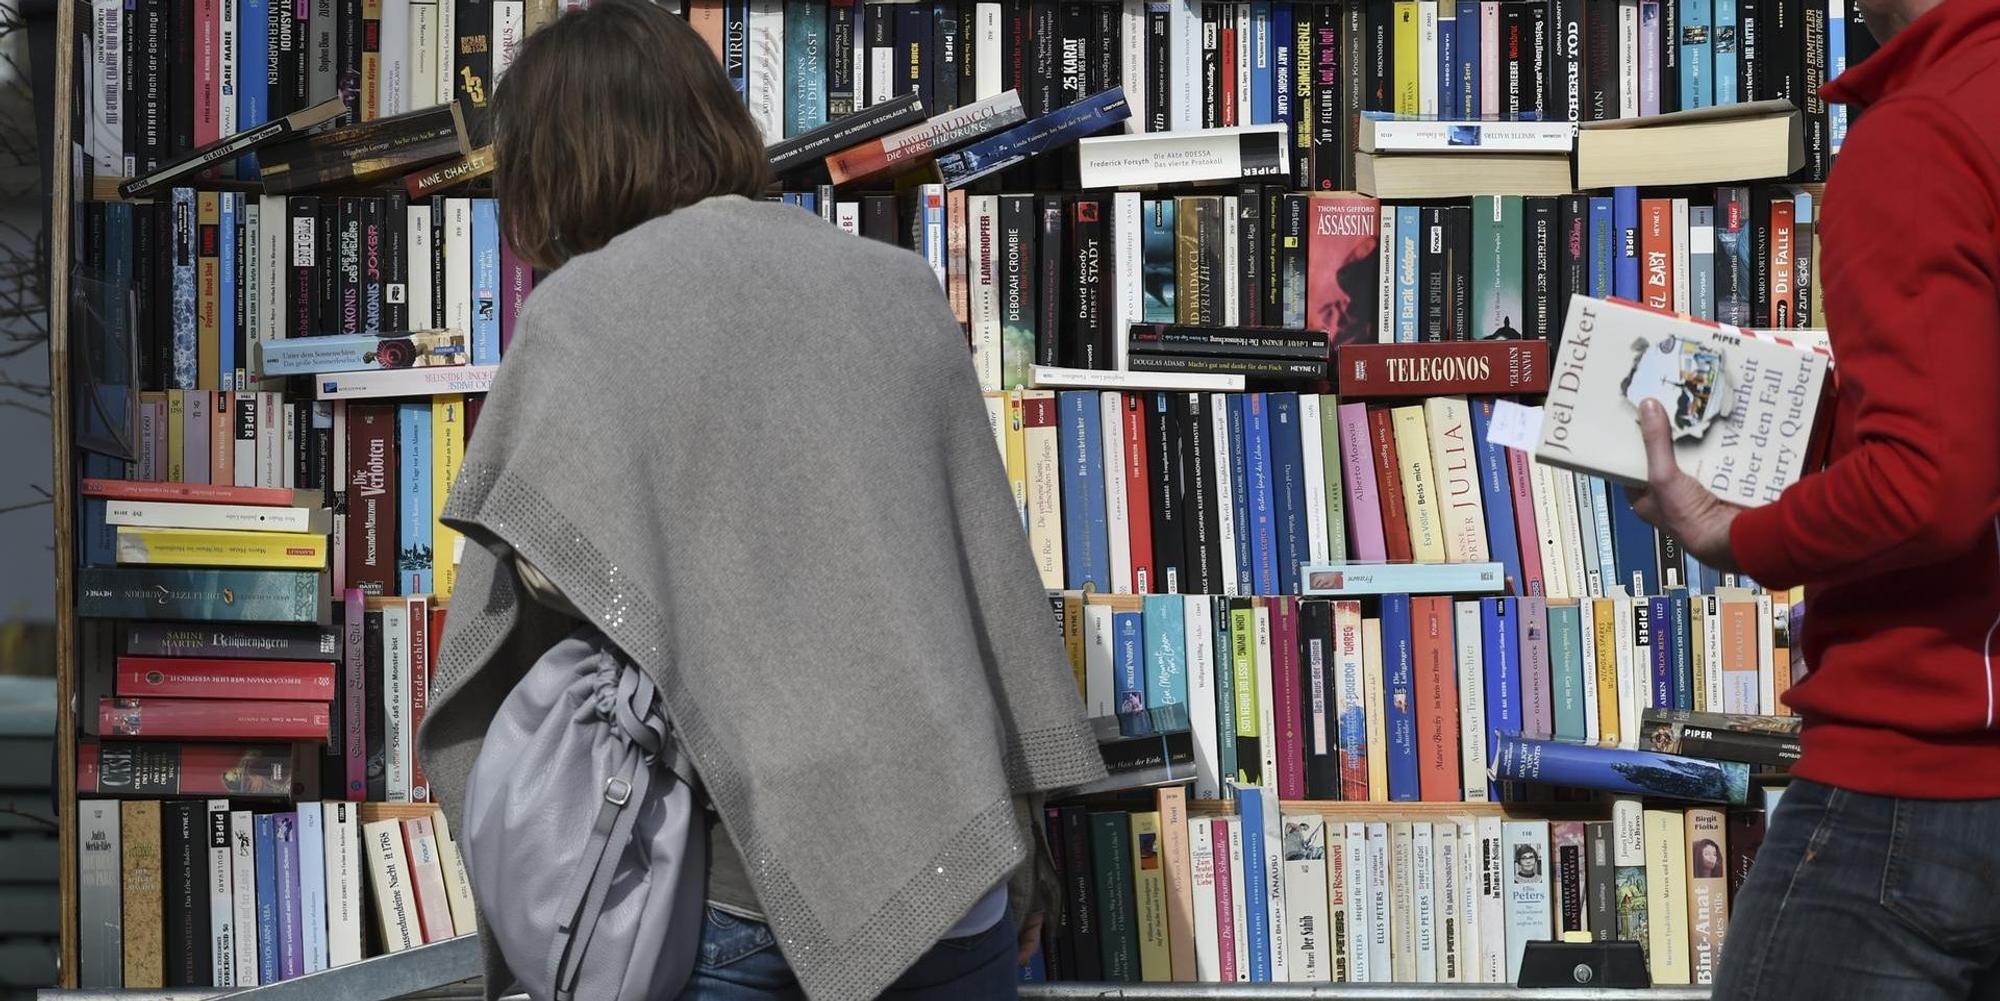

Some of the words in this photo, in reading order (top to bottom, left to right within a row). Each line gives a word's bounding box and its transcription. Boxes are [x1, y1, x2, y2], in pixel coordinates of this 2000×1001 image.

[148, 12, 160, 54] Schlange
[280, 11, 292, 51] ASMODI
[1745, 18, 1754, 45] RATTEN
[1816, 10, 1824, 32] FORCE
[223, 31, 232, 62] MARIE
[730, 21, 743, 70] VIRUS
[808, 32, 816, 74] ANGST
[911, 42, 919, 64] BUICK
[946, 36, 954, 62] PIPER
[1534, 21, 1544, 71] Valentinstag
[1566, 22, 1578, 58] TOD
[1745, 46, 1754, 60] DIE
[1806, 9, 1816, 95] EURO-ERMITTLER
[1816, 34, 1824, 68] COUNTER
[148, 55, 158, 71] der
[1062, 38, 1078, 74] KARAT
[1278, 46, 1288, 66] MARY
[1298, 22, 1310, 96] SCHMERZGRENZE
[148, 74, 158, 98] Nacht
[223, 65, 232, 96] MARIE
[798, 57, 806, 98] STEVENS
[911, 66, 919, 79] DER
[1062, 76, 1078, 90] 25
[1278, 67, 1288, 94] HIGGINS
[1746, 62, 1754, 90] Herbert
[808, 80, 816, 100] DIE
[1278, 95, 1288, 115] CLARK
[1535, 71, 1544, 112] Schwarzer
[1567, 62, 1578, 137] SICHERE
[808, 106, 816, 120] IN
[1807, 97, 1816, 114] DIE
[148, 102, 158, 145] WATKINS
[834, 132, 844, 140] MIT
[844, 120, 871, 137] BLINDHEIT
[872, 106, 908, 126] GESCHLAGEN
[898, 131, 930, 148] DAVID
[930, 104, 998, 138] BALDACCI
[1812, 121, 1820, 150] Molsner
[886, 146, 902, 162] DIE
[902, 122, 986, 156] VERSCHWÖRUNG
[418, 172, 442, 190] ANNE
[444, 158, 486, 180] CHAPLET
[1247, 224, 1256, 239] Riga
[1317, 214, 1374, 237] ASSASSINI
[1730, 208, 1738, 228] Knaur
[298, 218, 311, 266] ENIGMA
[342, 231, 350, 255] SPUR
[350, 221, 358, 262] SPIELERS
[368, 224, 379, 280] JOKER
[980, 216, 991, 286] FLAMMENOPFER
[1008, 228, 1019, 272] CROMBIE
[1432, 232, 1440, 252] Knaur
[1538, 219, 1546, 271] LEHRLING
[1626, 229, 1634, 256] PIPER
[1758, 227, 1766, 276] FORTUNATO
[342, 257, 350, 272] DIE
[350, 264, 358, 282] DES
[1080, 248, 1088, 284] Moody
[1088, 238, 1098, 284] STADT
[1247, 256, 1256, 278] Hunde
[1189, 250, 1200, 308] BALDACCI
[1538, 273, 1546, 292] DER
[1758, 276, 1766, 304] MARIO
[344, 288, 356, 334] KAKONIS
[366, 282, 380, 333] KAKONIS
[1008, 275, 1020, 320] DEBORAH
[1080, 288, 1088, 318] David
[1558, 306, 1596, 394] Dicker
[1386, 356, 1490, 383] TELEGONOS
[1522, 351, 1532, 383] HANNS
[1760, 368, 1783, 406] Fall
[1781, 356, 1815, 438] Quebert
[1721, 358, 1760, 450] Wahrheit
[1544, 402, 1575, 452] Joël
[1750, 409, 1774, 446] den
[1348, 422, 1360, 464] Moravia
[352, 470, 366, 485] Die
[360, 439, 386, 496] Verlobten
[1444, 424, 1478, 509] JULIA
[1490, 456, 1498, 470] SWIFT
[1712, 455, 1736, 492] Die
[1736, 448, 1758, 499] über
[1353, 466, 1364, 502] Alberto
[1492, 471, 1500, 492] GRAHAM
[365, 498, 376, 528] Manzoni
[365, 528, 376, 566] Alessandro
[90, 590, 112, 598] HEYNE
[166, 630, 204, 640] SABINE
[1638, 608, 1648, 644] PIPER
[162, 640, 204, 648] MARTIN
[414, 630, 422, 670] stehlen
[1310, 641, 1322, 666] Spinne
[1312, 668, 1321, 680] der
[1399, 640, 1408, 684] Luftgängerin
[414, 674, 424, 708] Pferde
[1312, 682, 1322, 698] Haus
[1392, 672, 1400, 684] Die
[1313, 700, 1323, 714] Das
[1402, 720, 1411, 755] Schneider
[1684, 728, 1712, 740] PIPER
[101, 750, 132, 787] CASE
[1519, 744, 1528, 764] LICHT
[1532, 746, 1541, 778] ATLANTIS
[1520, 766, 1528, 778] DAS
[215, 814, 224, 844] PIPER
[1695, 816, 1717, 824] Birgit
[90, 831, 106, 841] Judith
[1634, 837, 1642, 850] Der
[1482, 838, 1490, 870] PETERS
[1492, 872, 1500, 890] Namen
[1492, 892, 1500, 900] Im
[1512, 890, 1545, 902] Peters
[1375, 891, 1384, 920] PETERS
[1420, 895, 1429, 926] PETERS
[1714, 892, 1724, 913] Nils
[1079, 904, 1090, 934] Matilde
[1299, 915, 1314, 936] Sahib
[1376, 922, 1384, 944] ELLIS
[1716, 916, 1724, 938] des
[1301, 936, 1314, 950] Der
[1356, 934, 1364, 960] PETERS
[1420, 928, 1430, 951] ELLIS
[1445, 918, 1454, 953] PETERS
[1694, 885, 1712, 984] Bint-Anat
[1356, 962, 1364, 981] ELLIS
[1446, 954, 1455, 978] ELLIS
